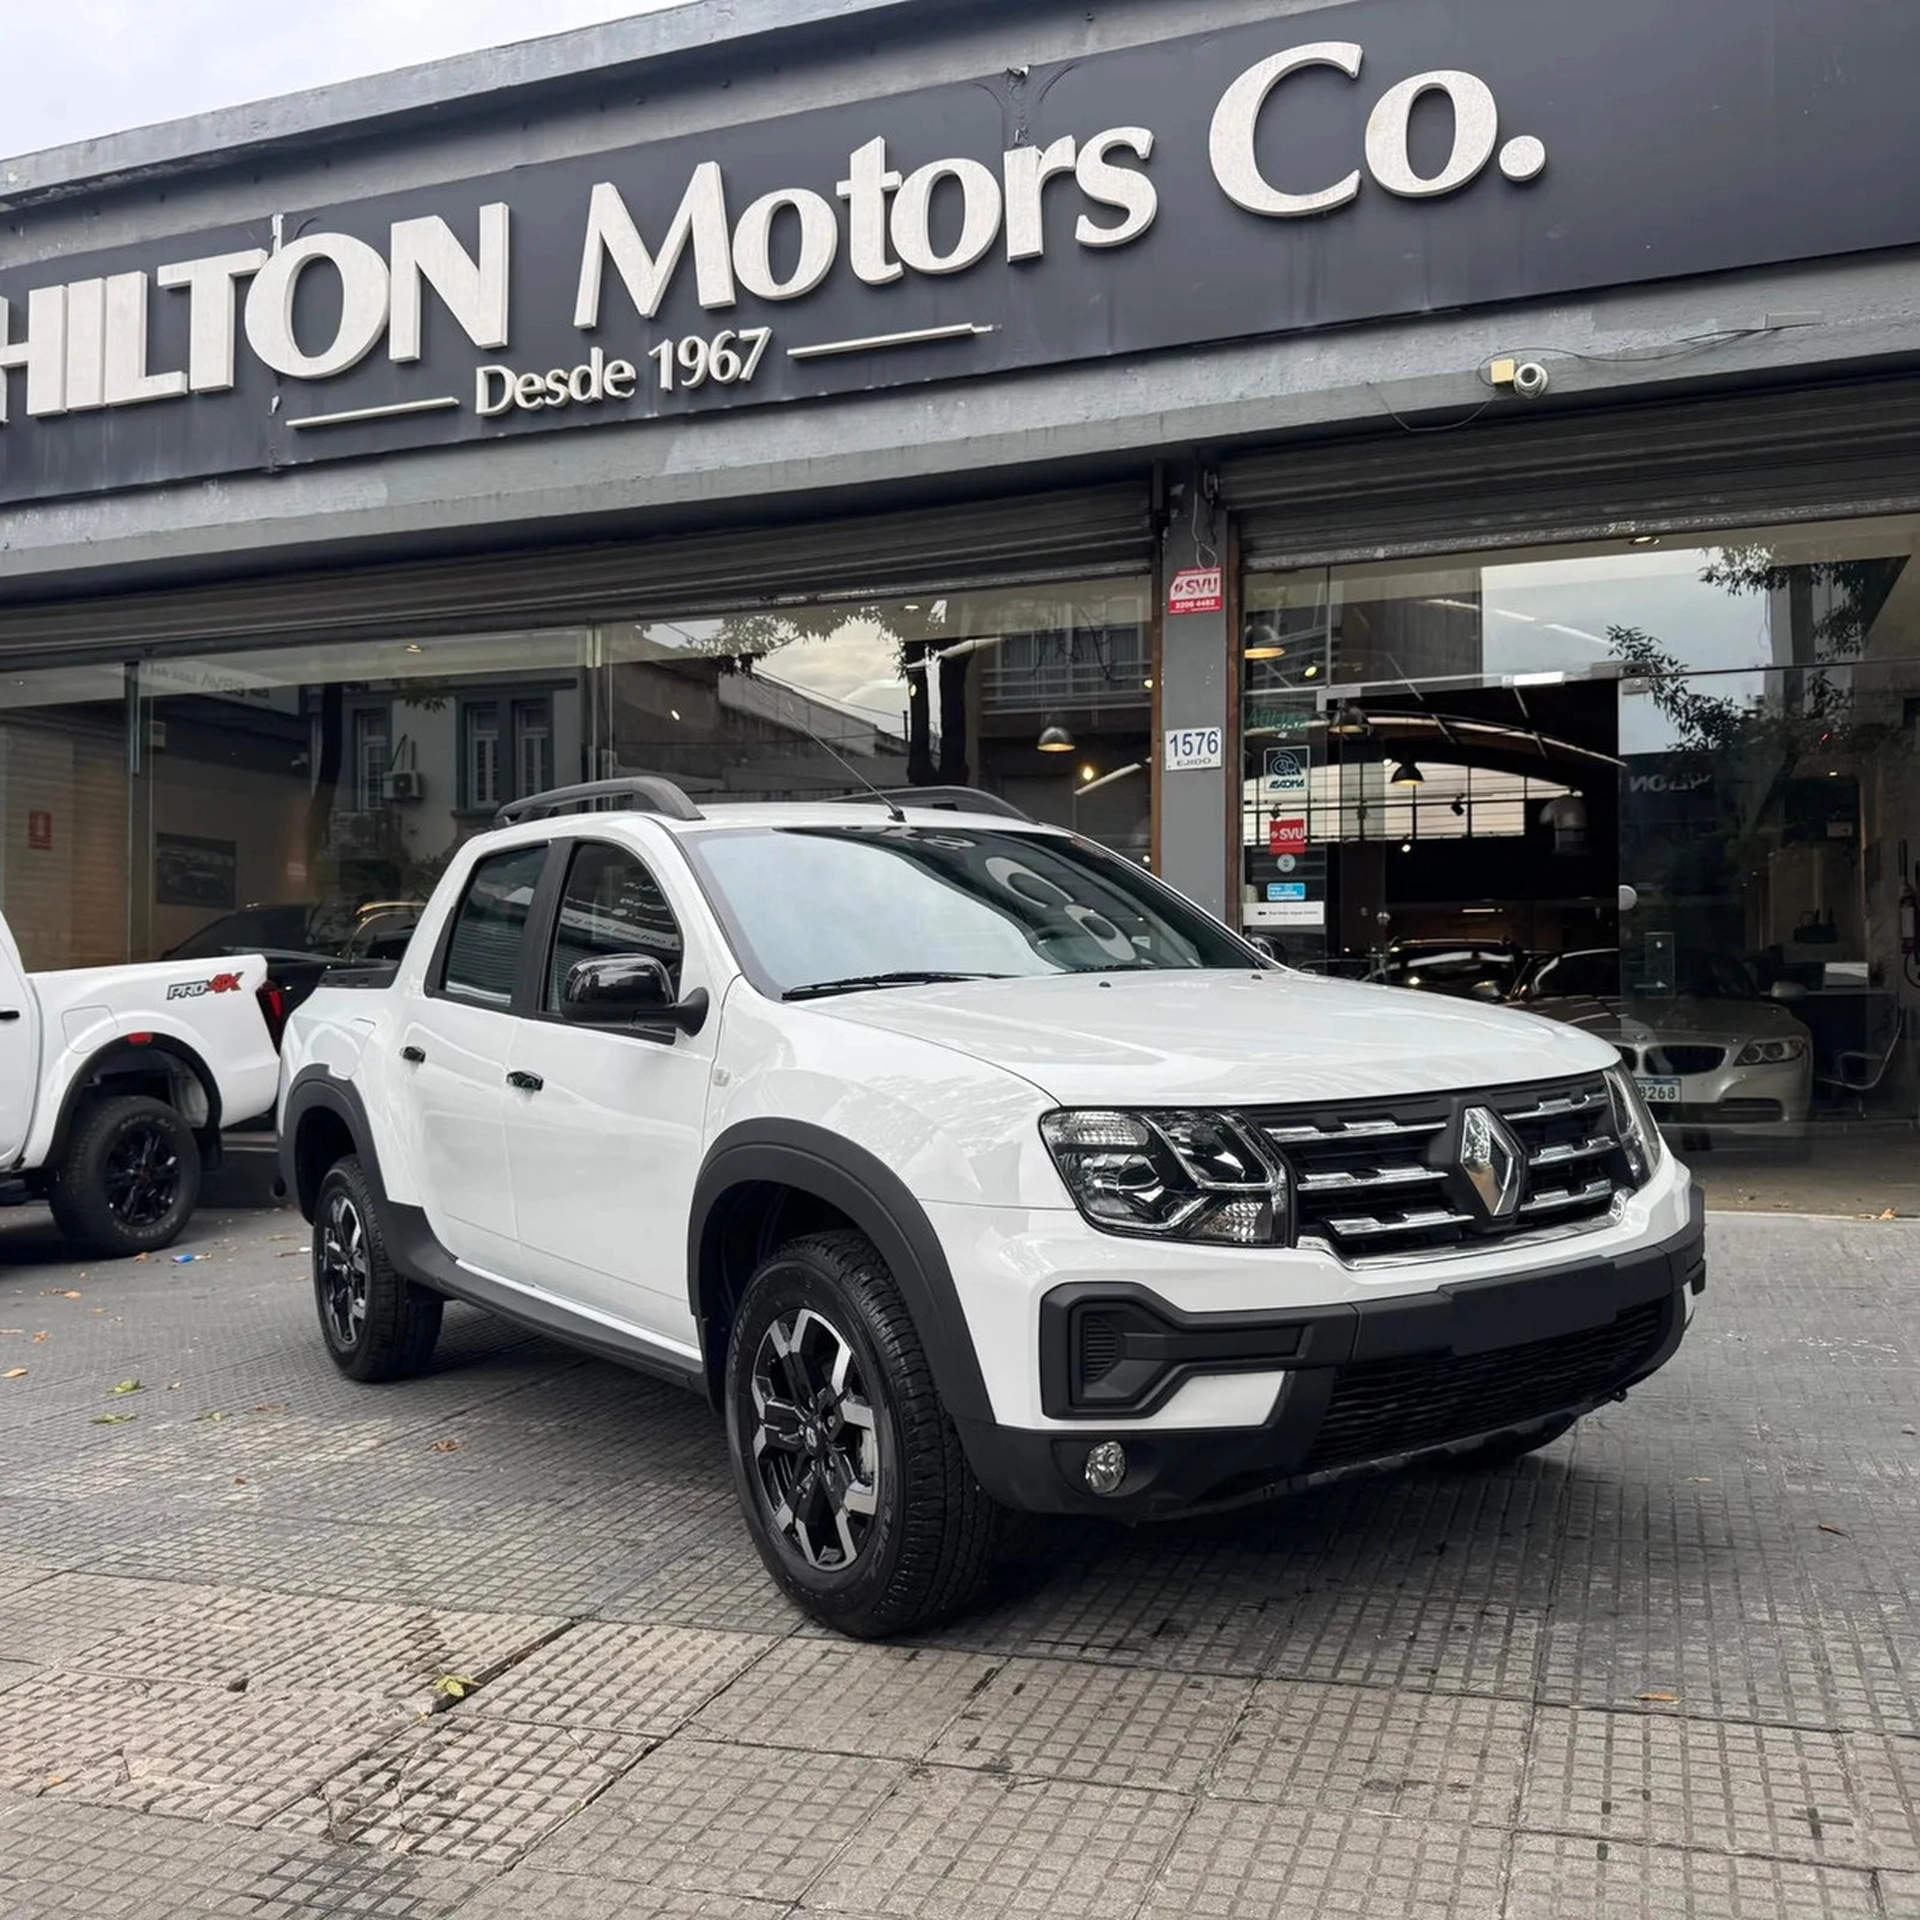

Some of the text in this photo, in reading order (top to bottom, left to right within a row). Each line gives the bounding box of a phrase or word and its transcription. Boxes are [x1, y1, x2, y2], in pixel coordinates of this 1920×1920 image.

[0, 41, 1546, 423] HILTON Motors Co.
[476, 327, 772, 416] Desde 1967
[1186, 576, 1218, 594] SVU
[1169, 731, 1218, 757] 1576
[1279, 828, 1304, 840] SVU
